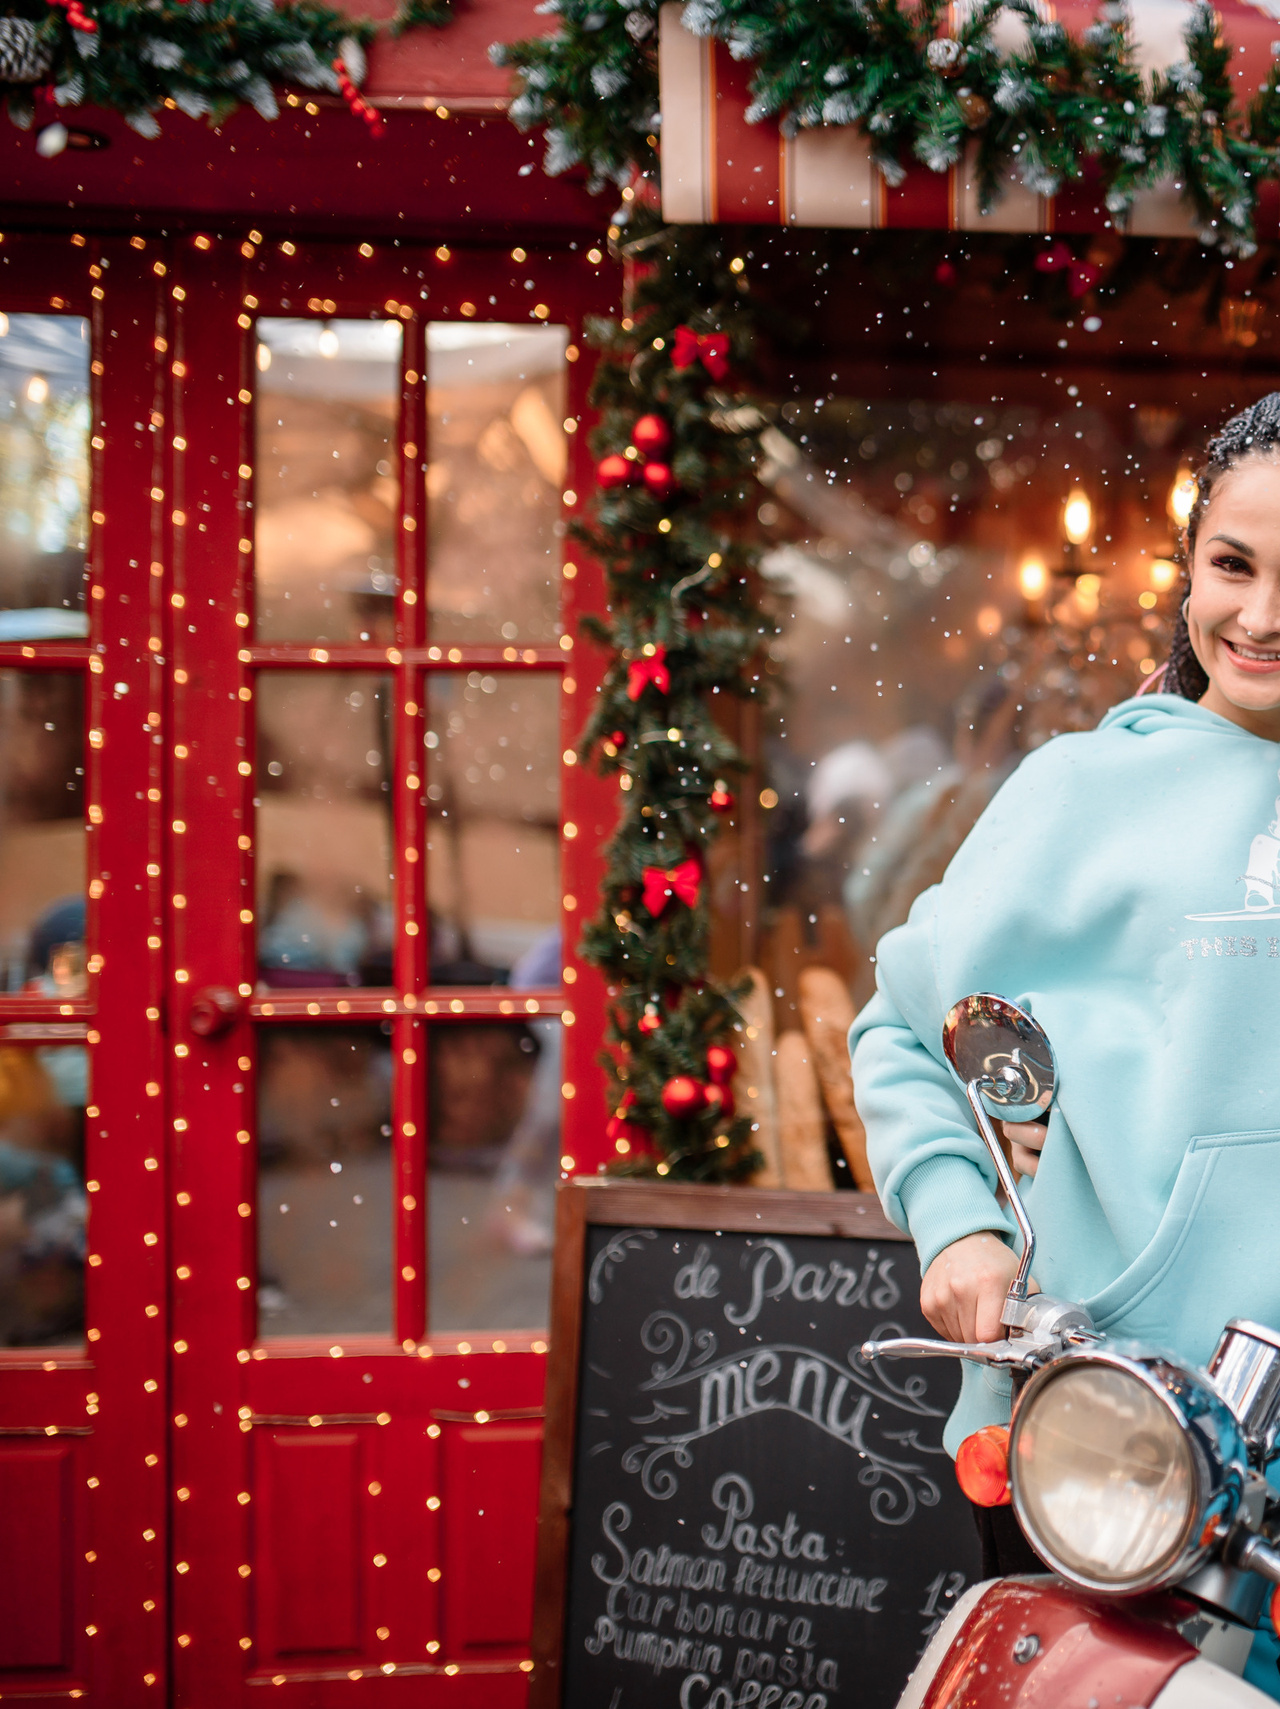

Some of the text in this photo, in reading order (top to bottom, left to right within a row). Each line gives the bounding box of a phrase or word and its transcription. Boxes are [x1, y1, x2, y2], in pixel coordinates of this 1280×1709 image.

[1180, 934, 1258, 960] THIS
[673, 1238, 900, 1326] de Paris
[699, 1352, 874, 1450] menu
[591, 1501, 726, 1592] Salmon
[606, 1583, 816, 1649] Carbonara
[730, 1648, 840, 1692] pasta
